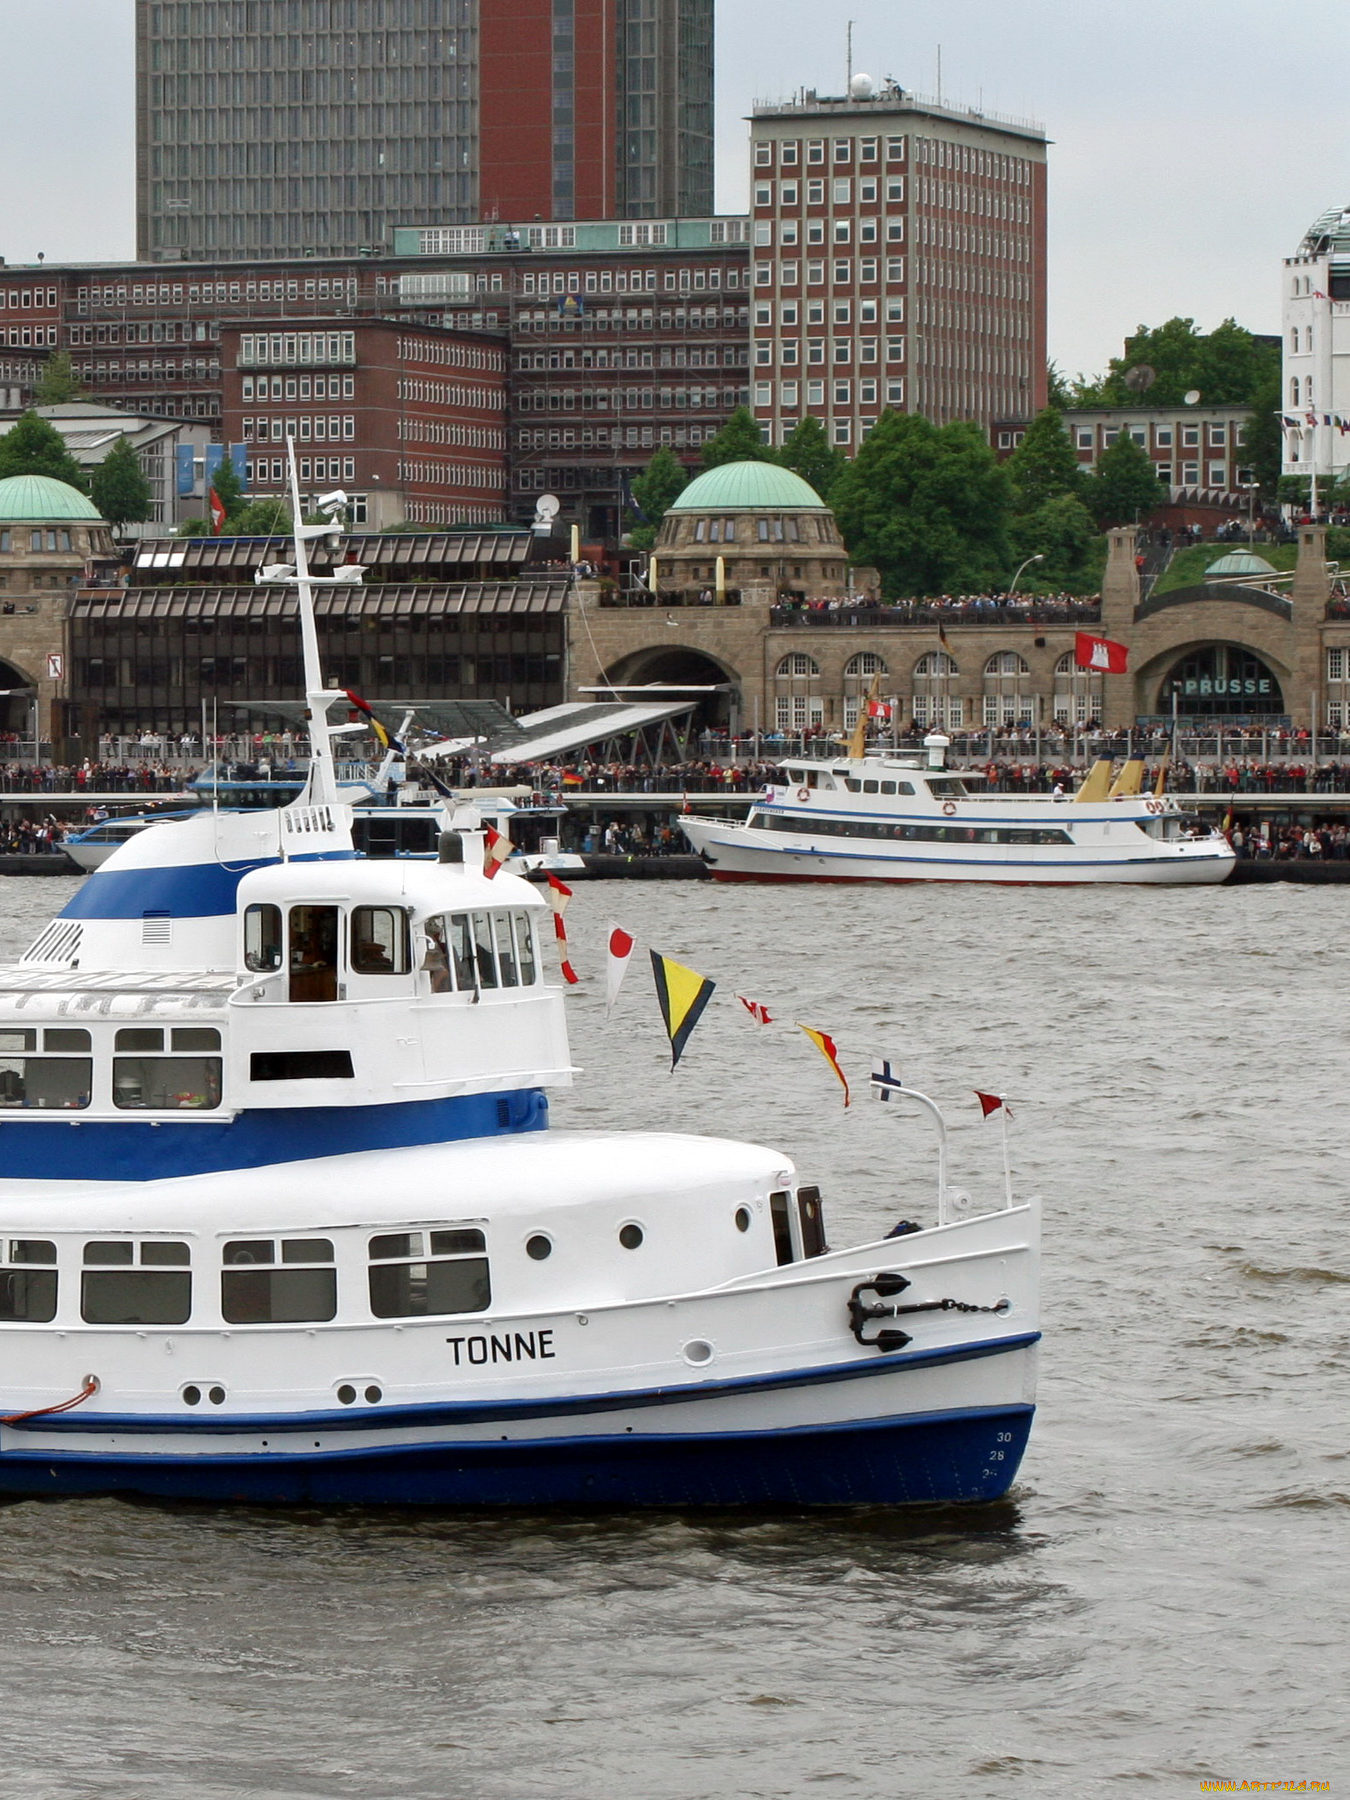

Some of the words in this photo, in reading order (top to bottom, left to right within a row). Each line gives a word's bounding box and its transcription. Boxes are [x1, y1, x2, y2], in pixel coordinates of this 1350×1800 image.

[1185, 676, 1270, 694] PRÜSSE
[446, 1329, 555, 1366] TONNE
[996, 1432, 1012, 1442] 30
[989, 1450, 1005, 1461] 28
